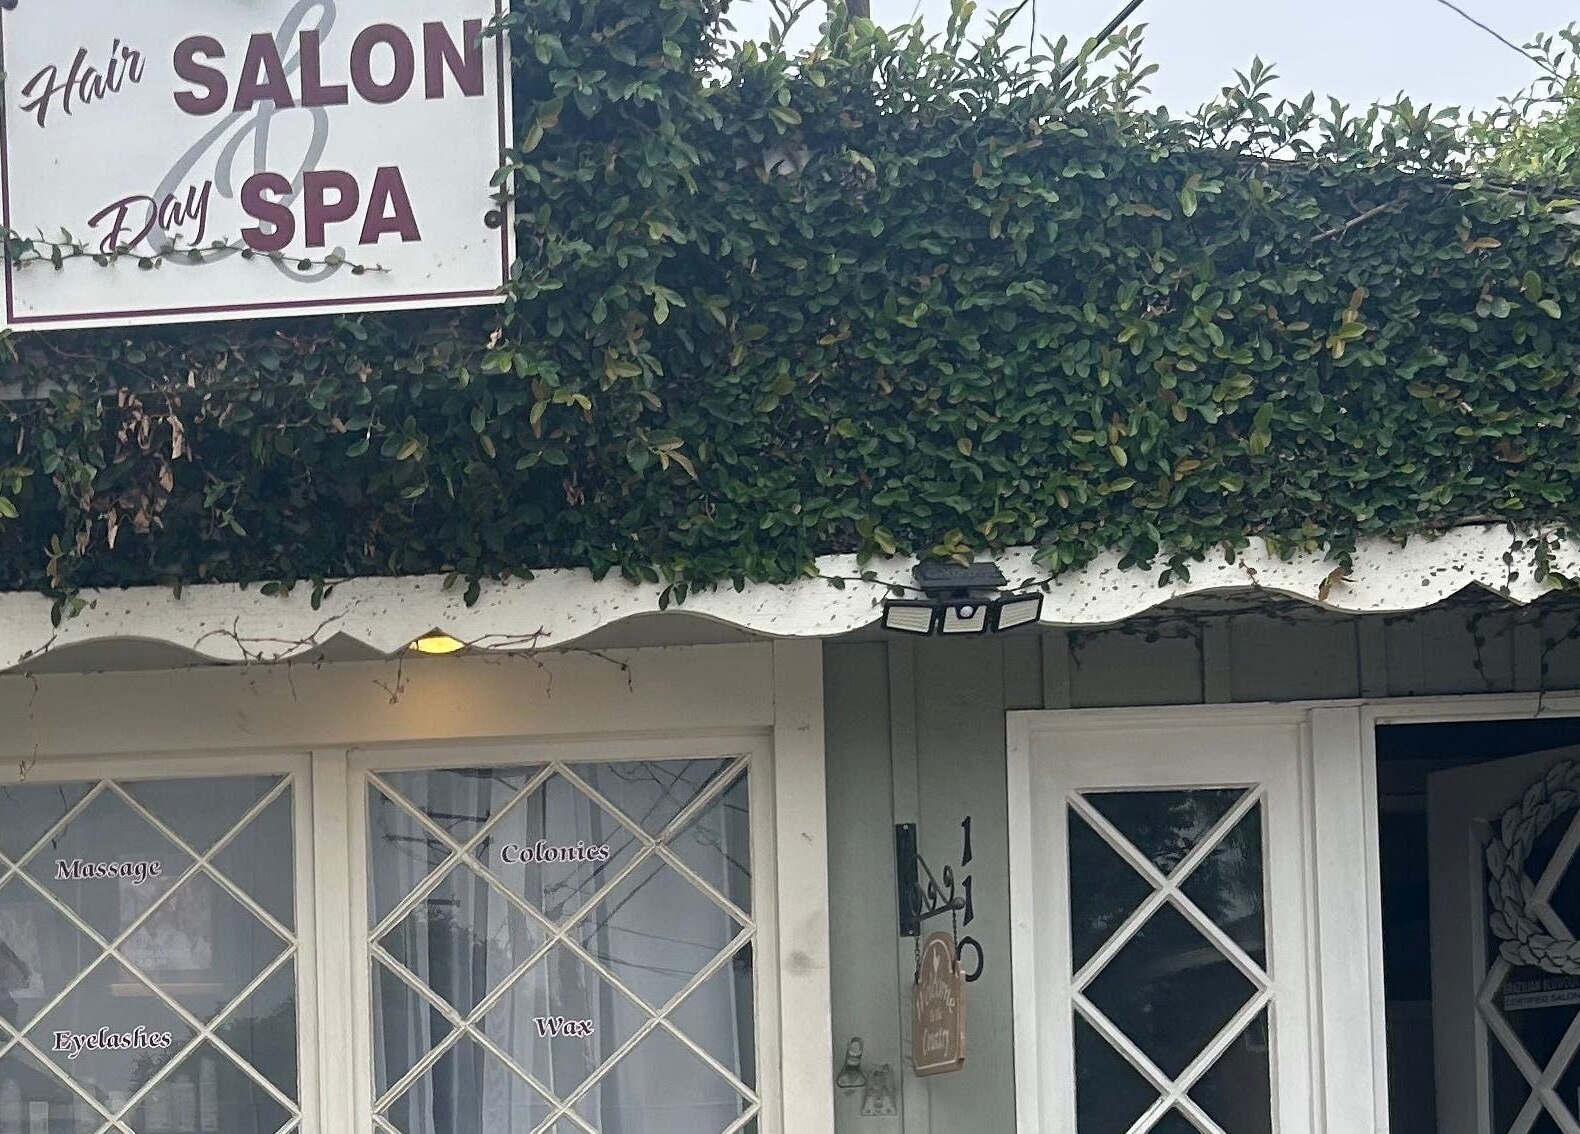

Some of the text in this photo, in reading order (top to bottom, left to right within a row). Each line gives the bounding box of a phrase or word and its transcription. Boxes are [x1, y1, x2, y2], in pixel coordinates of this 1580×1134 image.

[20, 19, 486, 128] Hair SALON
[87, 165, 423, 254] Day SPA
[501, 839, 610, 865] Colonics
[54, 858, 163, 886] Massage
[51, 1025, 172, 1060] Eyelashes
[532, 1016, 595, 1038] Wax
